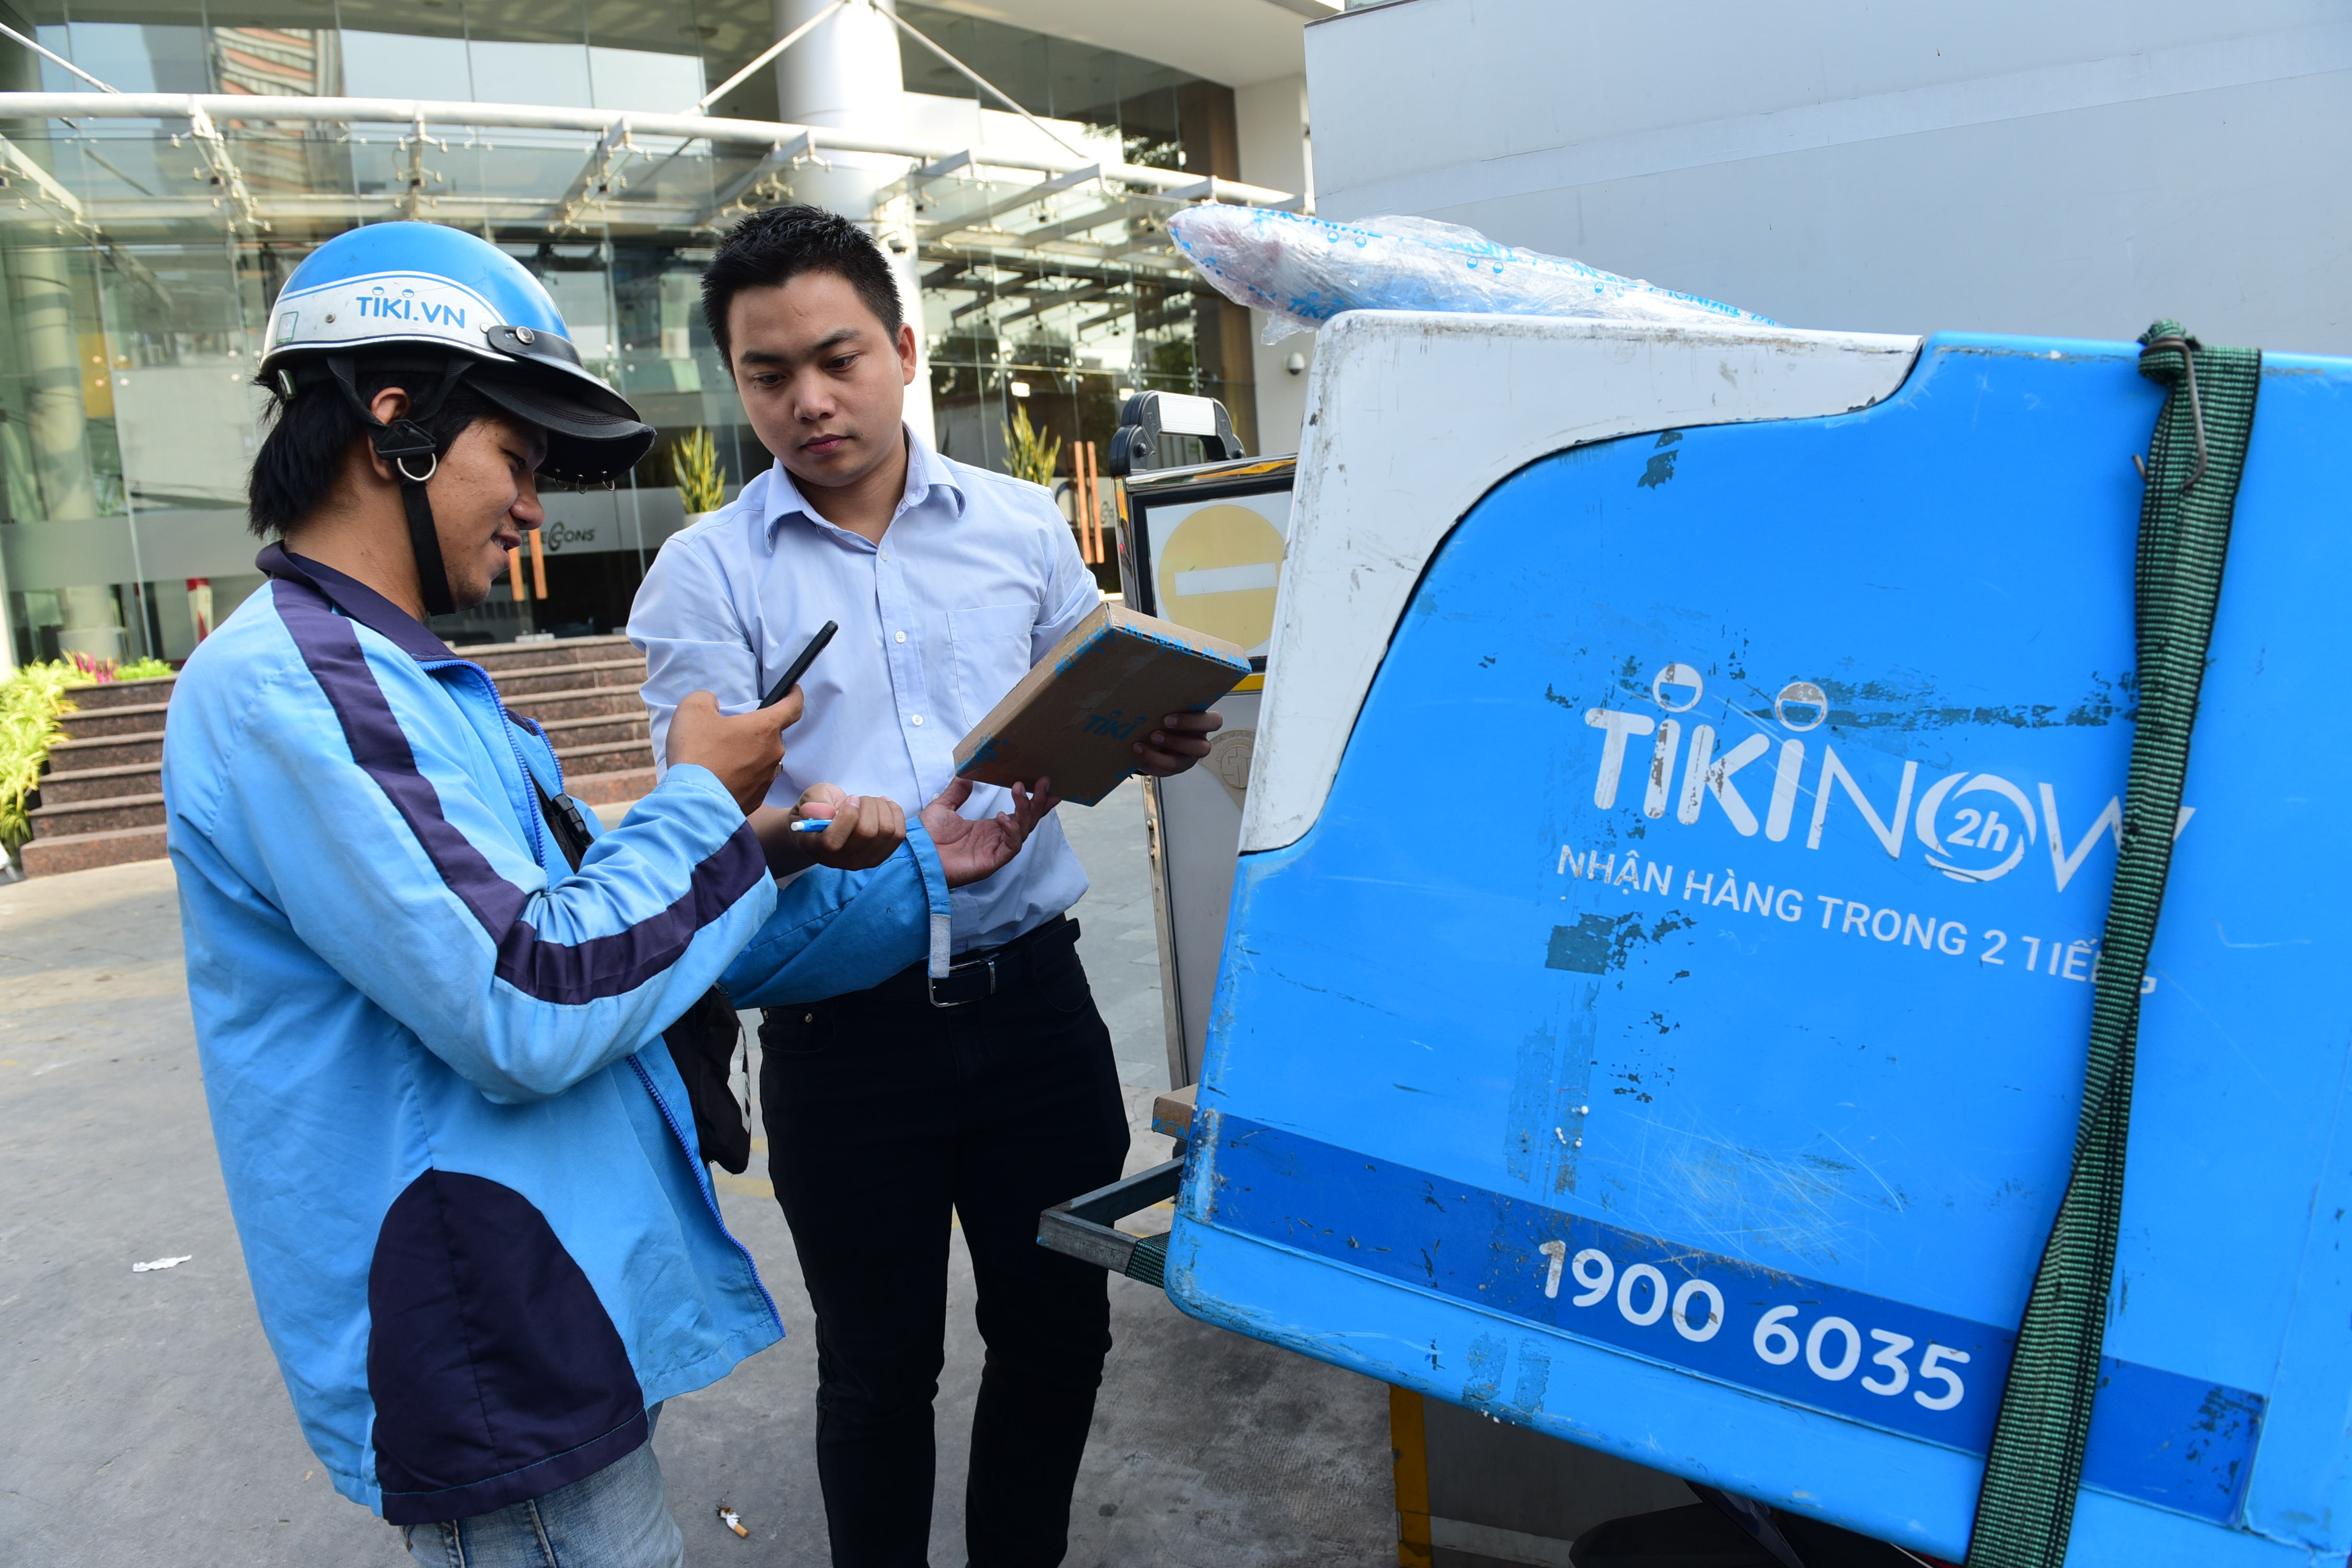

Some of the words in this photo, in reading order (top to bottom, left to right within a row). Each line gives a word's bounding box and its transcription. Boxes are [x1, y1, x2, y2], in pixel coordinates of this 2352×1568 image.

[356, 286, 466, 329] TIKI.VN
[1946, 808, 2010, 852] 2h
[1557, 844, 1673, 896] NHẬN
[1683, 868, 1804, 922] HÀNG
[1817, 895, 1968, 956] TRONG
[1980, 929, 2007, 965] 2
[2022, 935, 2157, 995] TIẾ
[1539, 1240, 1724, 1342] 1900
[1753, 1305, 1970, 1411] 6035
